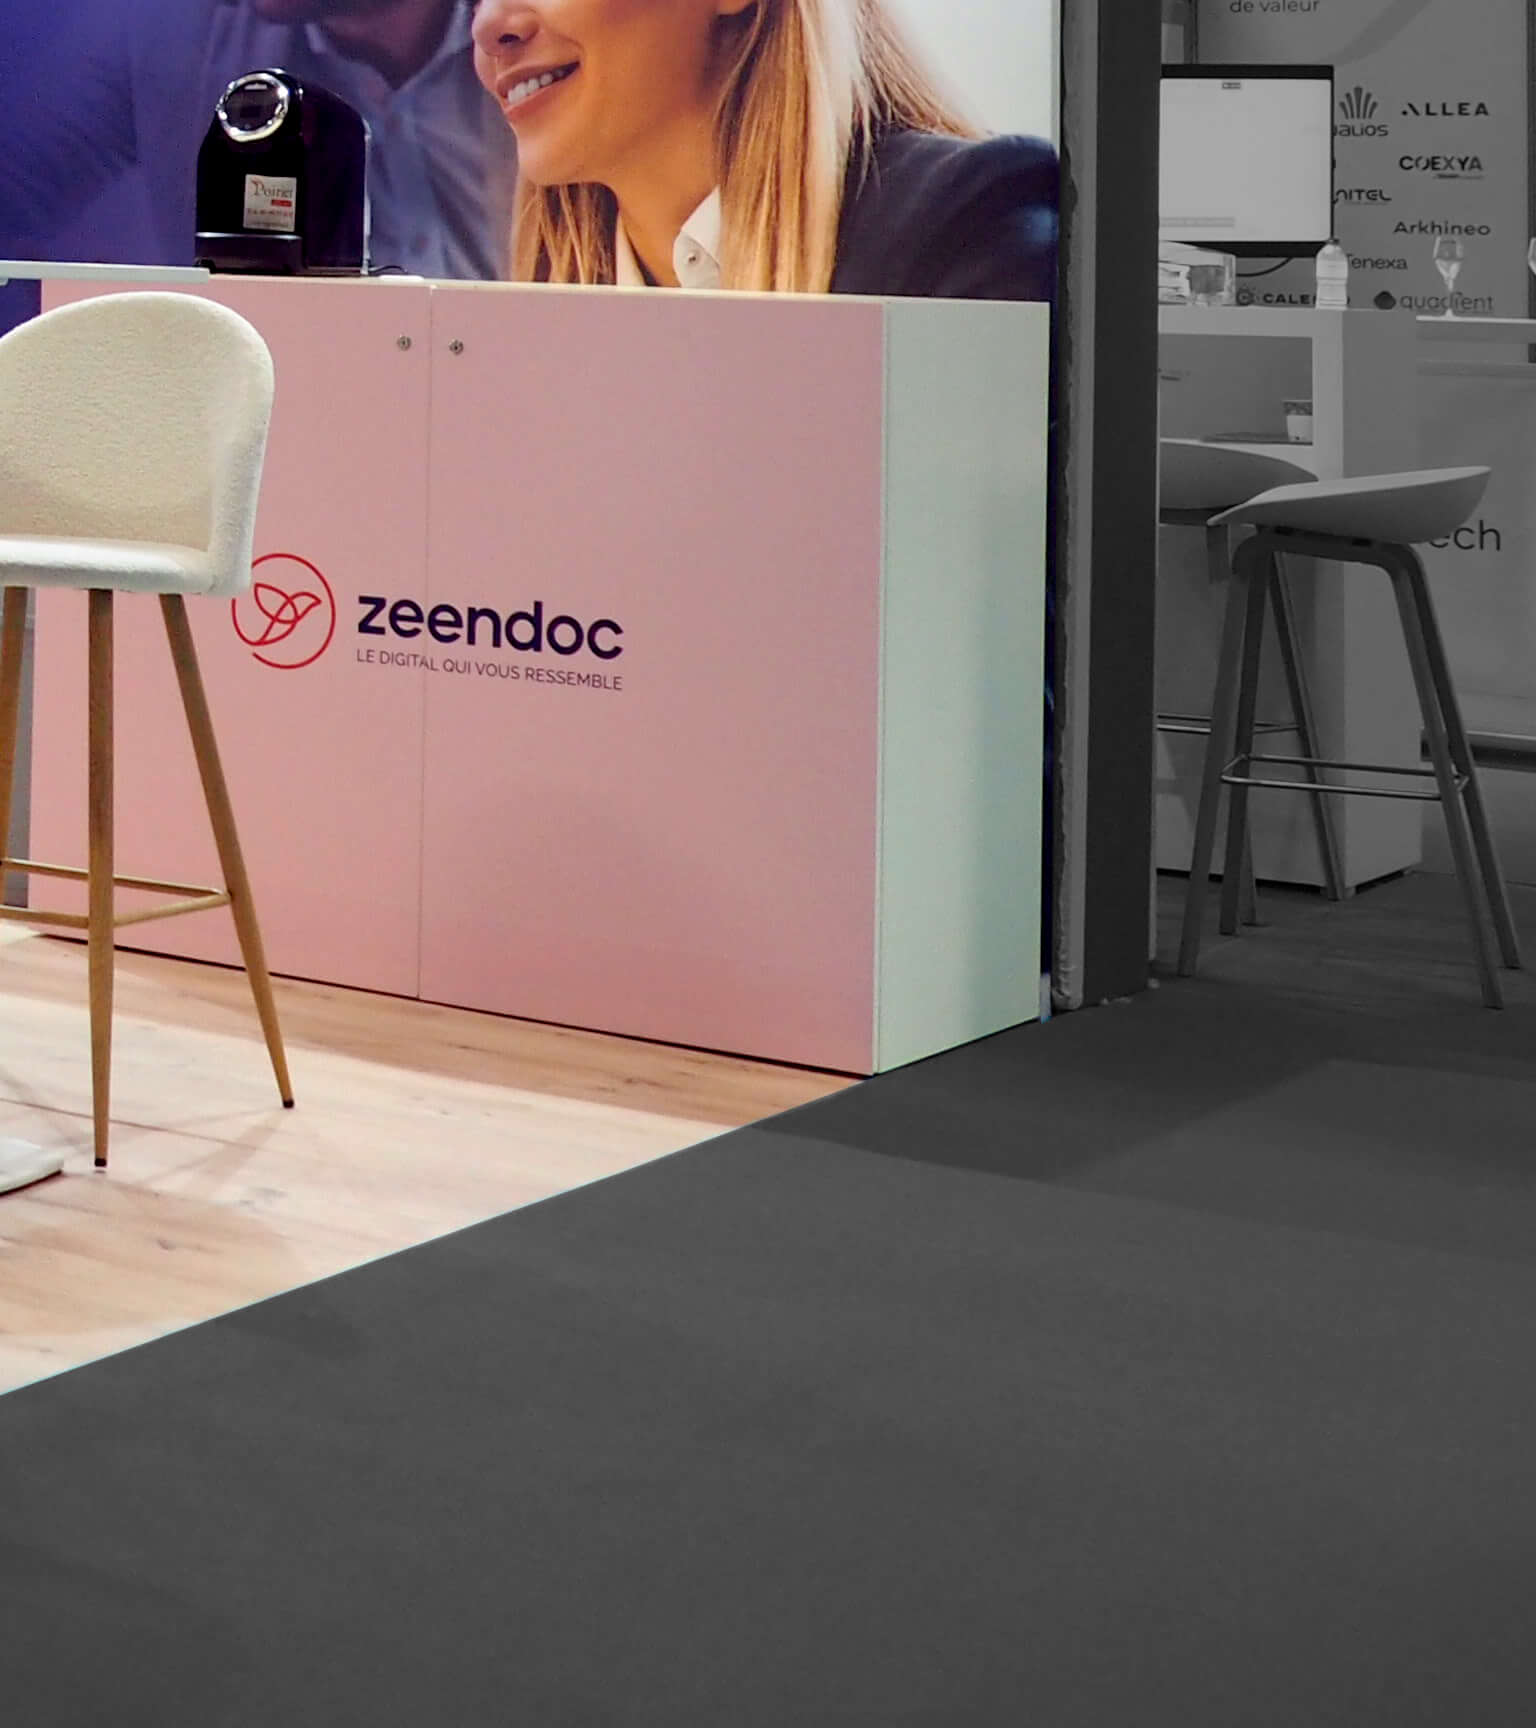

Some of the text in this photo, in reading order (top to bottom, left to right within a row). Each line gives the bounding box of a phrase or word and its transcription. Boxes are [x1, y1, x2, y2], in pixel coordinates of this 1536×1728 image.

[1393, 221, 1490, 235] Arkhineo
[358, 595, 623, 660] zeendoc
[356, 648, 623, 690] LE DIGITAL QUI VOUS RESSEMBLE
